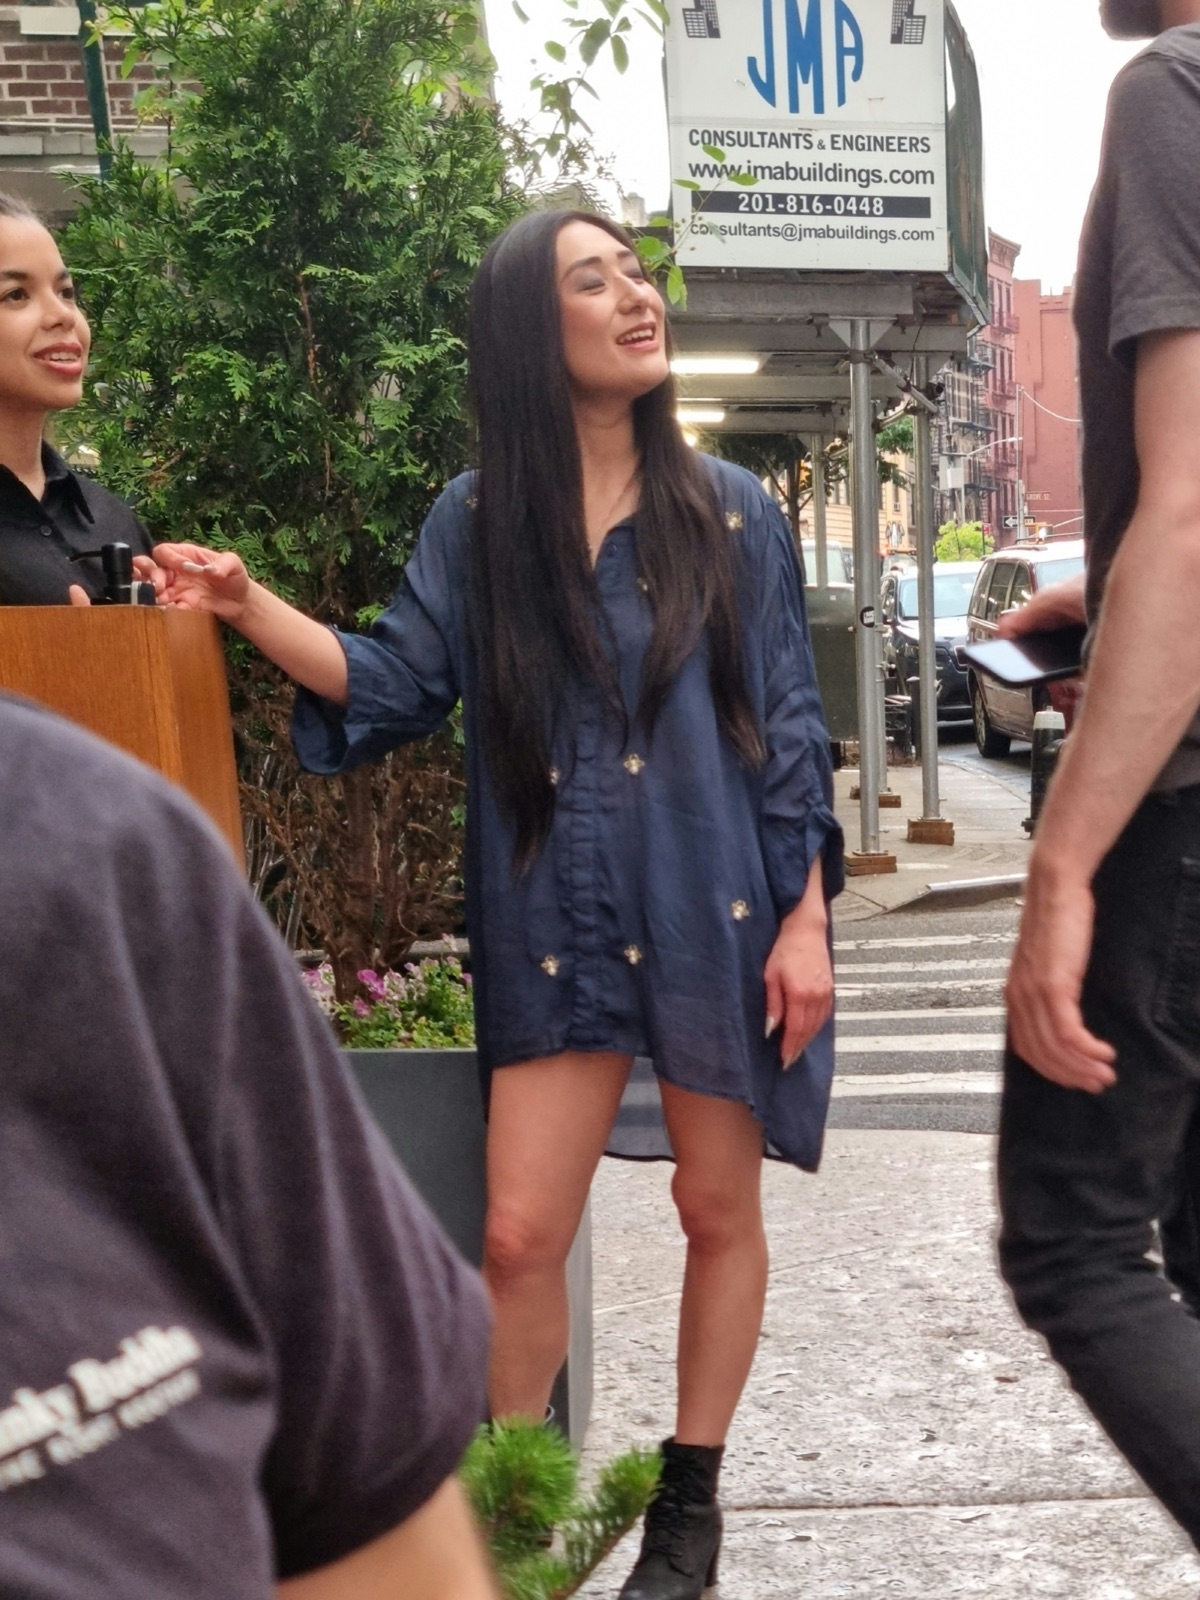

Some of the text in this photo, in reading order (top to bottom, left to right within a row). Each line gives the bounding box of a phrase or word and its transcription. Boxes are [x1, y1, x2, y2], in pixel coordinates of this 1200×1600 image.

[747, 0, 863, 114] JMA
[689, 129, 931, 153] CONSULTANTS & ENGINEERS
[688, 160, 935, 188] wwwjmabuildings.com
[738, 193, 884, 215] 201-816-0448
